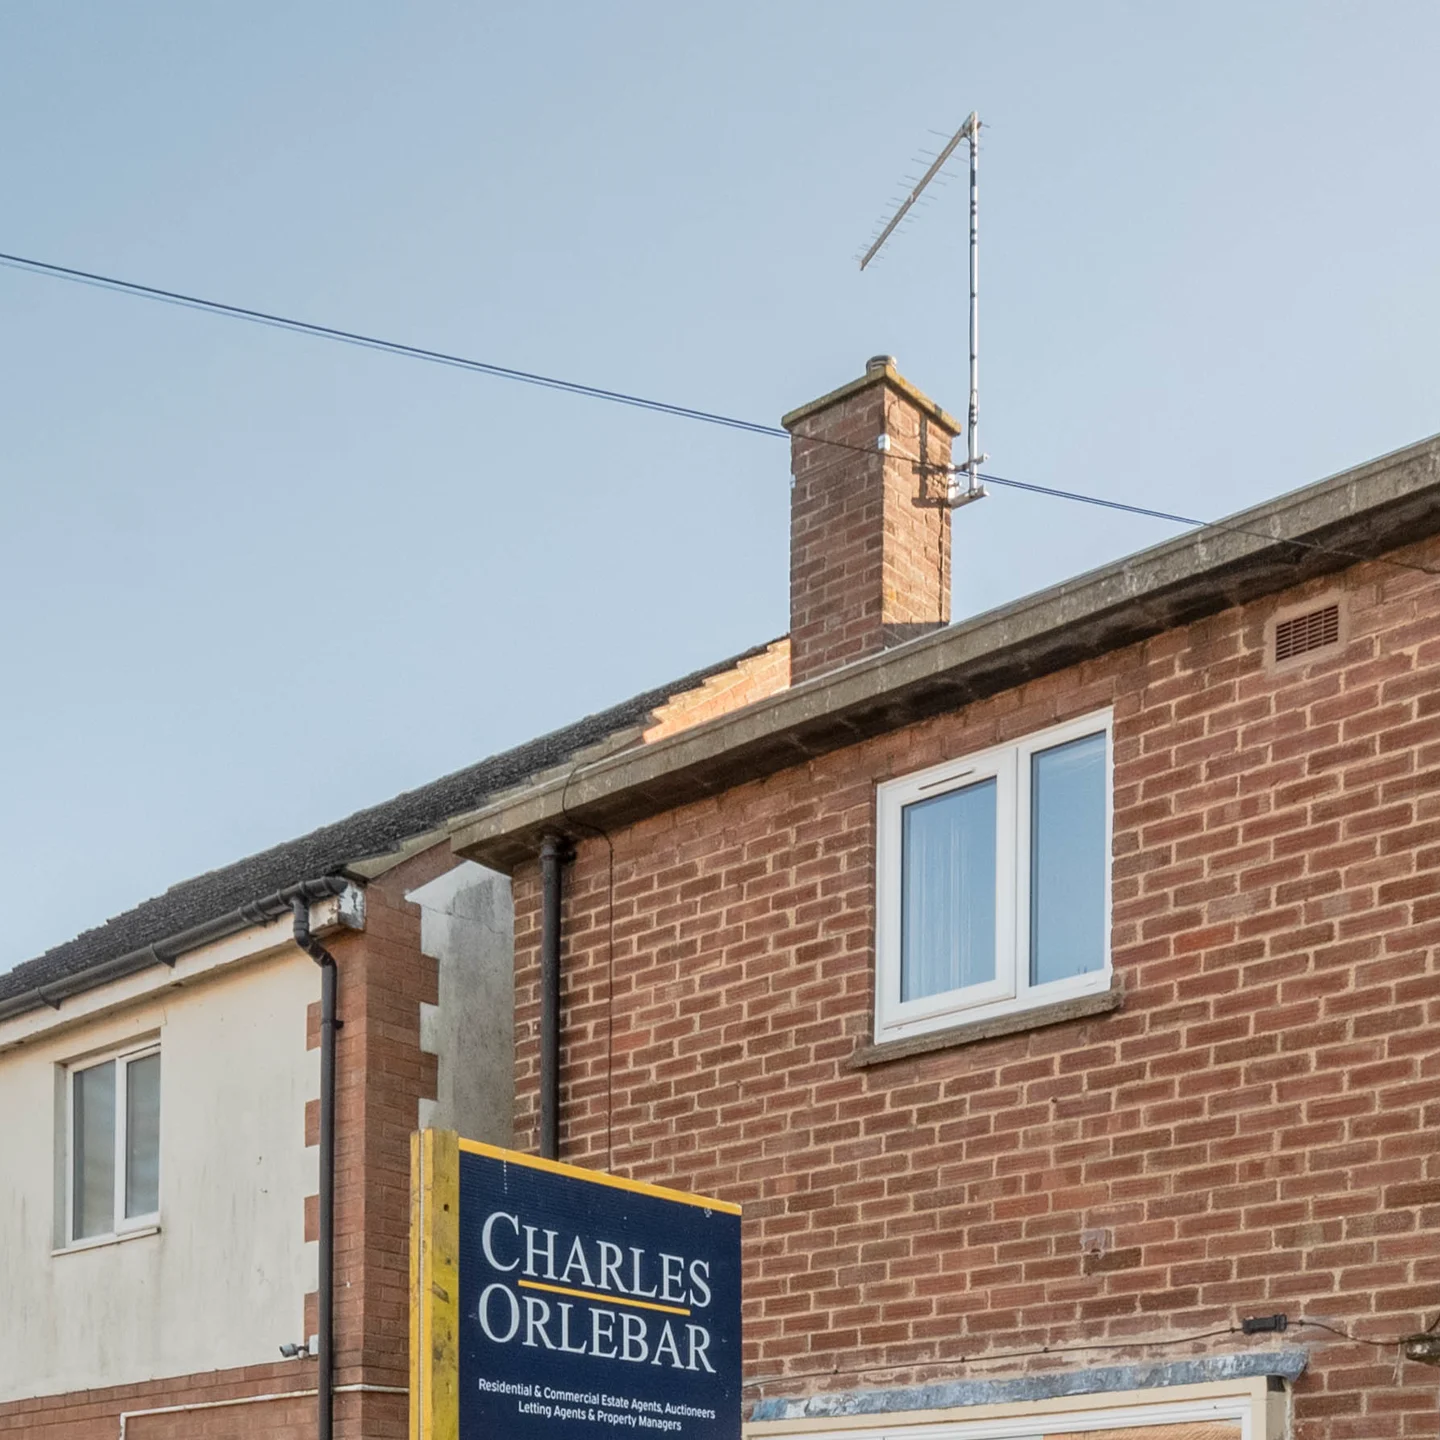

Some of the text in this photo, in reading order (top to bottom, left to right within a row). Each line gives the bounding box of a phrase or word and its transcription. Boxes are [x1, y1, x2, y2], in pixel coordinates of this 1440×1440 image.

[482, 1211, 711, 1308] CHARLES
[478, 1283, 716, 1373] ORLEBAR
[479, 1378, 716, 1419] Residential & Commercial Estate Agents, Auctioneers
[518, 1401, 682, 1432] Letting Agents & Property Managers
